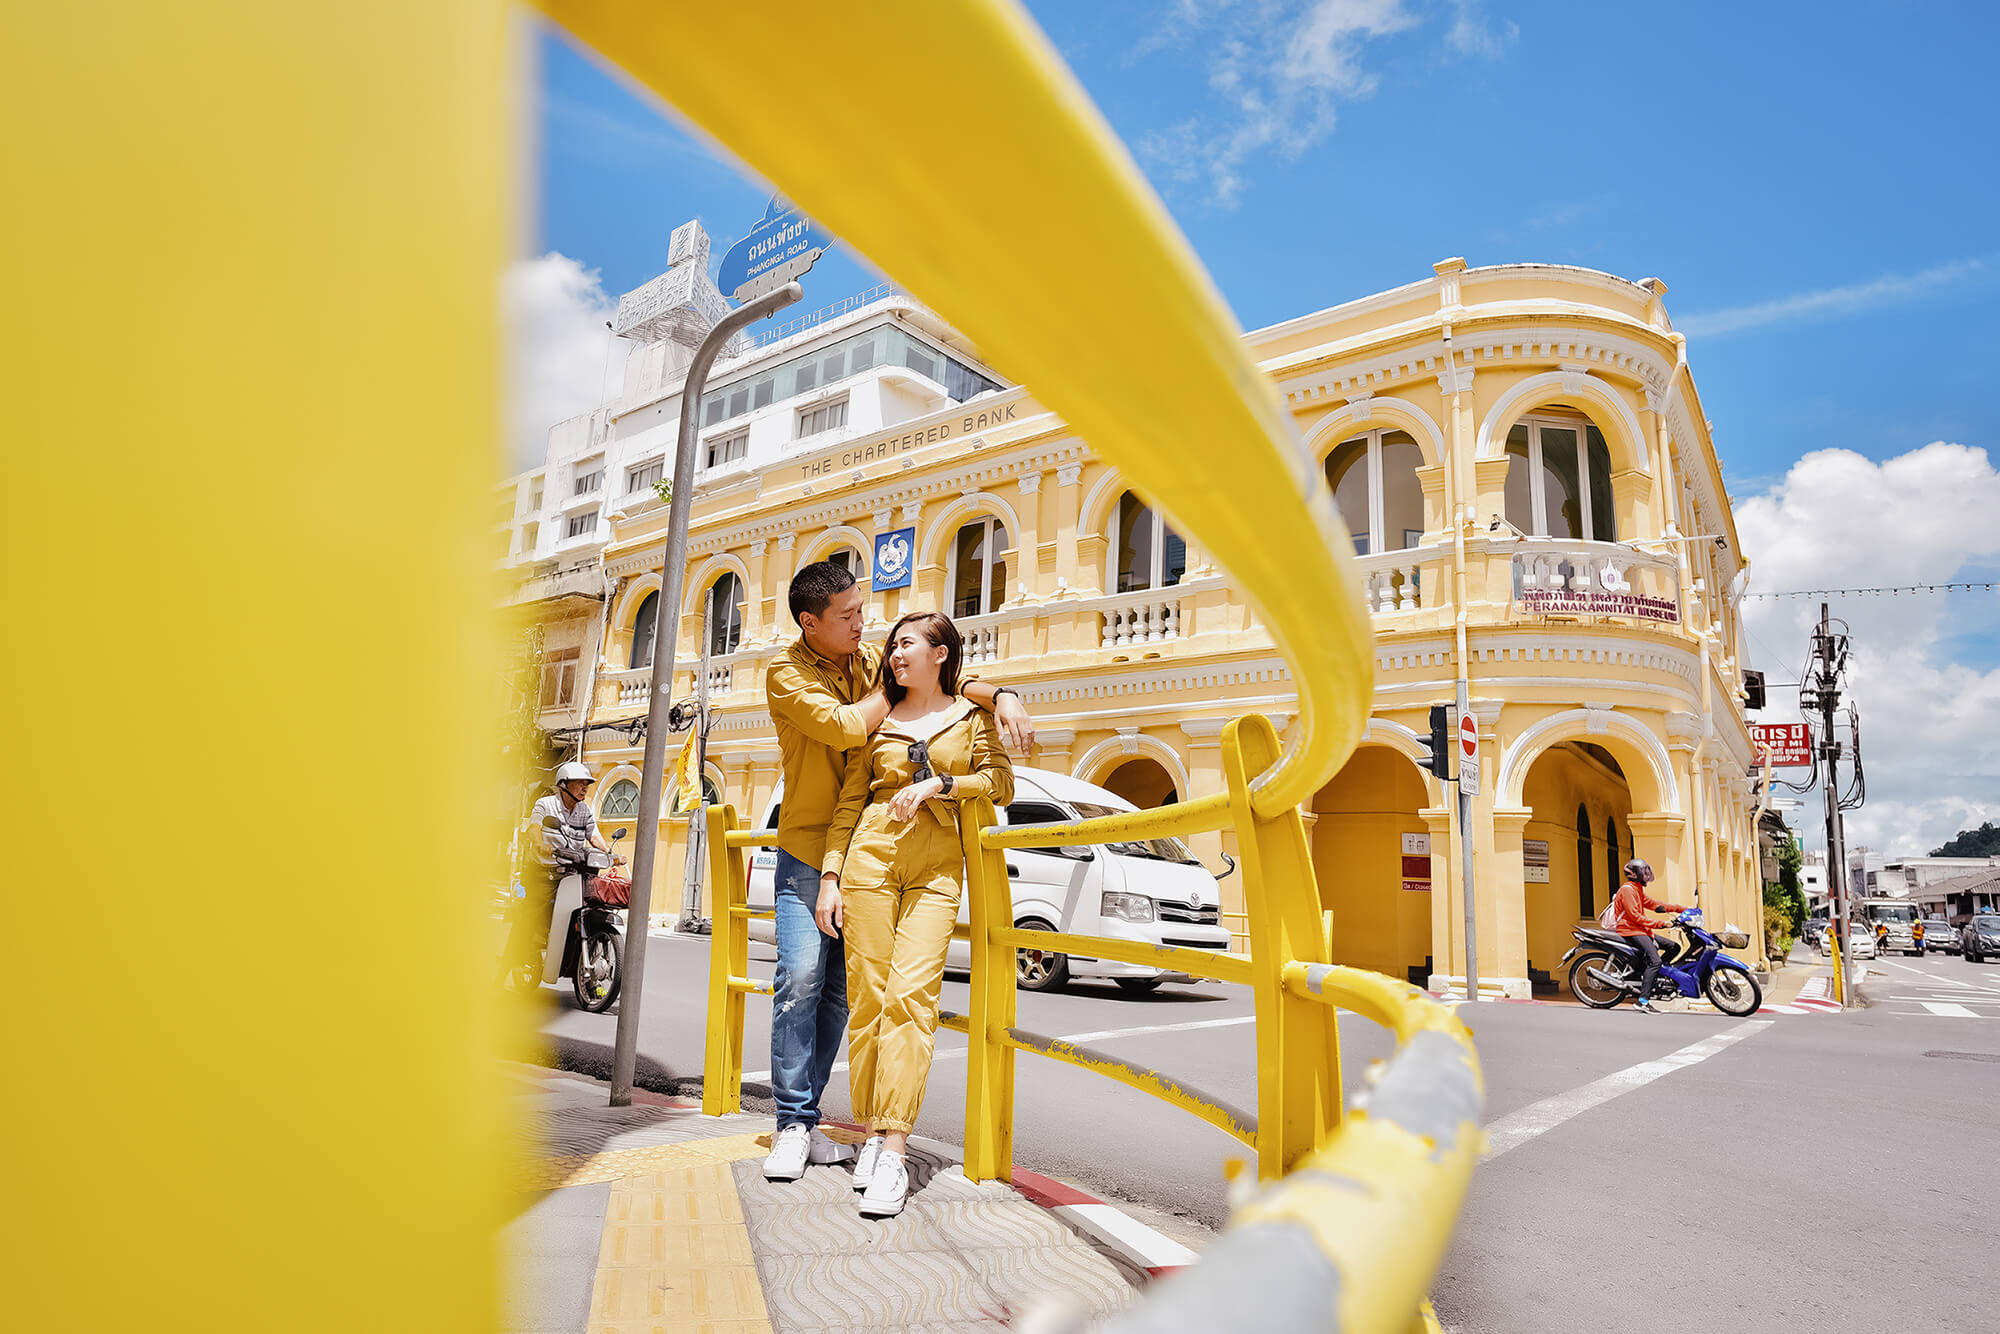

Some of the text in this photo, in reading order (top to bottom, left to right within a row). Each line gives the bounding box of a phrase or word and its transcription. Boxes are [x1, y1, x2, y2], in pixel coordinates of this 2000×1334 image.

[746, 239, 808, 279] PHANGNGA ROAD
[748, 217, 810, 262] ถนนพังงา
[801, 403, 1016, 479] THE CHARTERED BANK
[1637, 605, 1678, 622] MUSEUM
